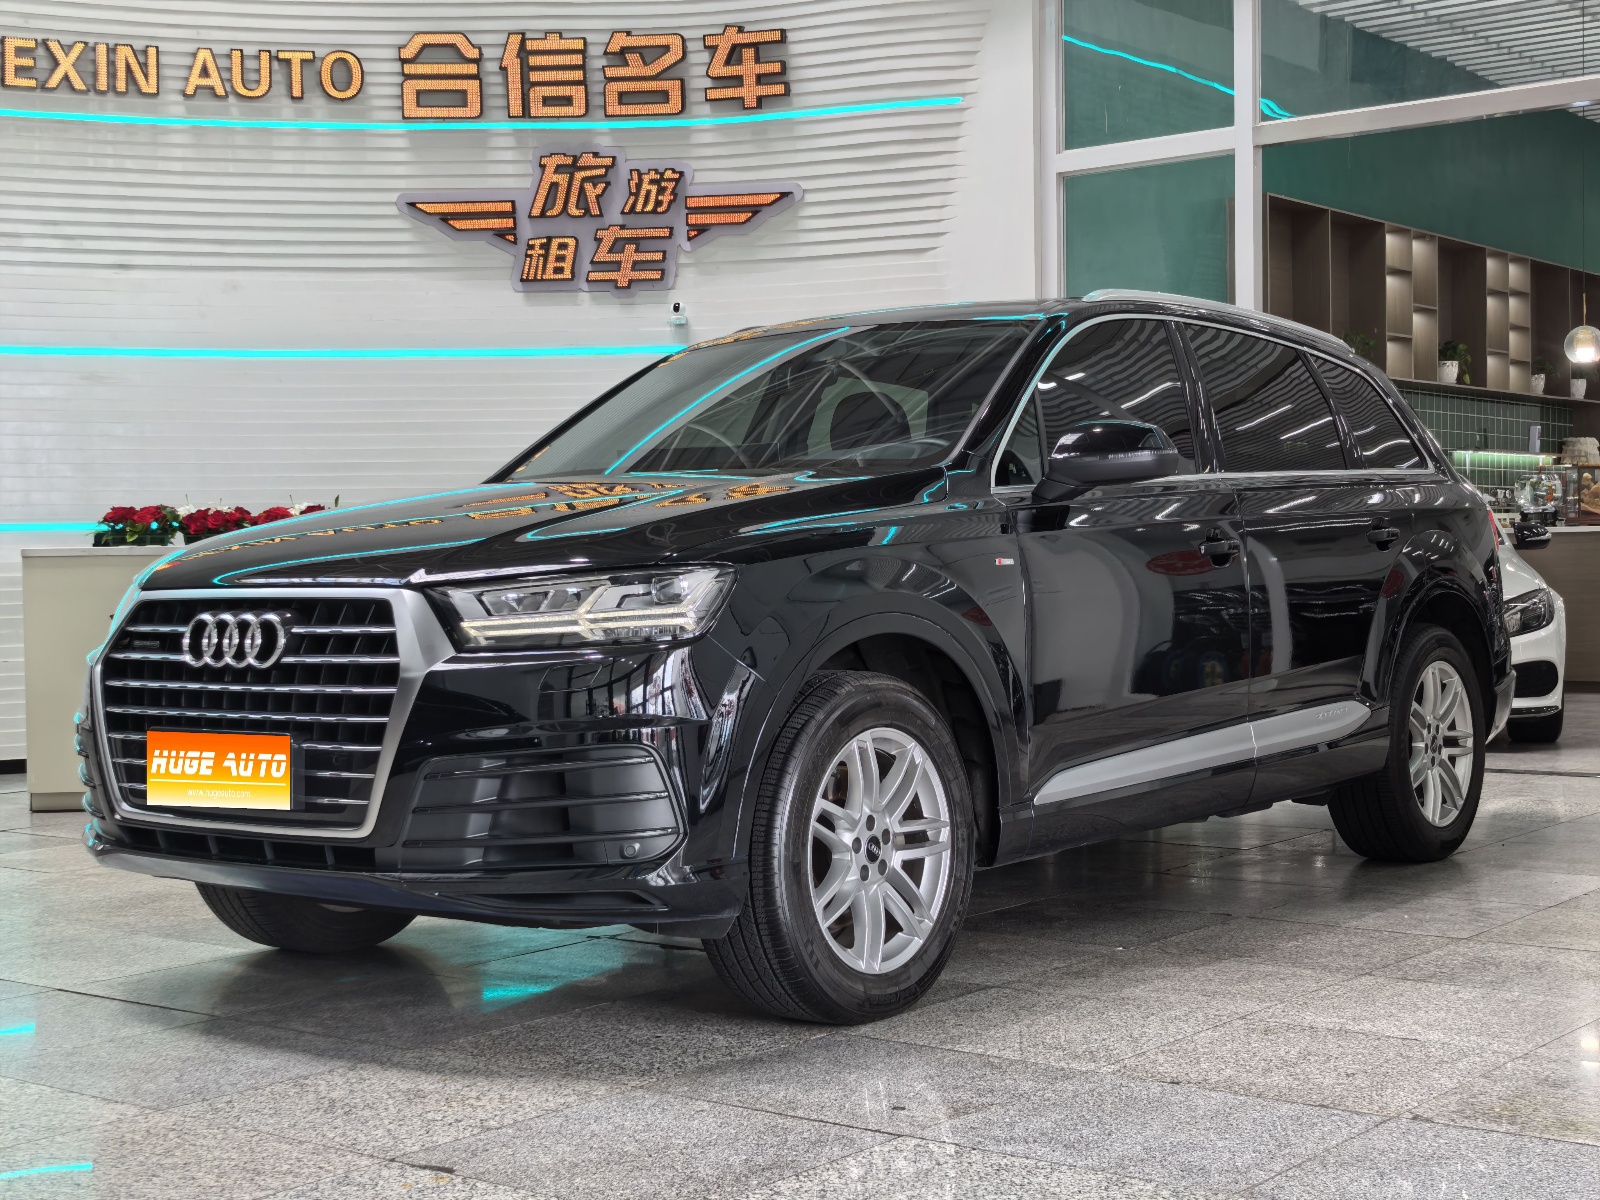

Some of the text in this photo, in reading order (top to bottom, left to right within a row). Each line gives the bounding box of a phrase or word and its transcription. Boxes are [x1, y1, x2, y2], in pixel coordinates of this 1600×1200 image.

[1, 36, 364, 101] EXIN AUTO
[399, 26, 790, 119] 合信名车
[528, 152, 684, 218] 旅游
[520, 224, 674, 289] 租车
